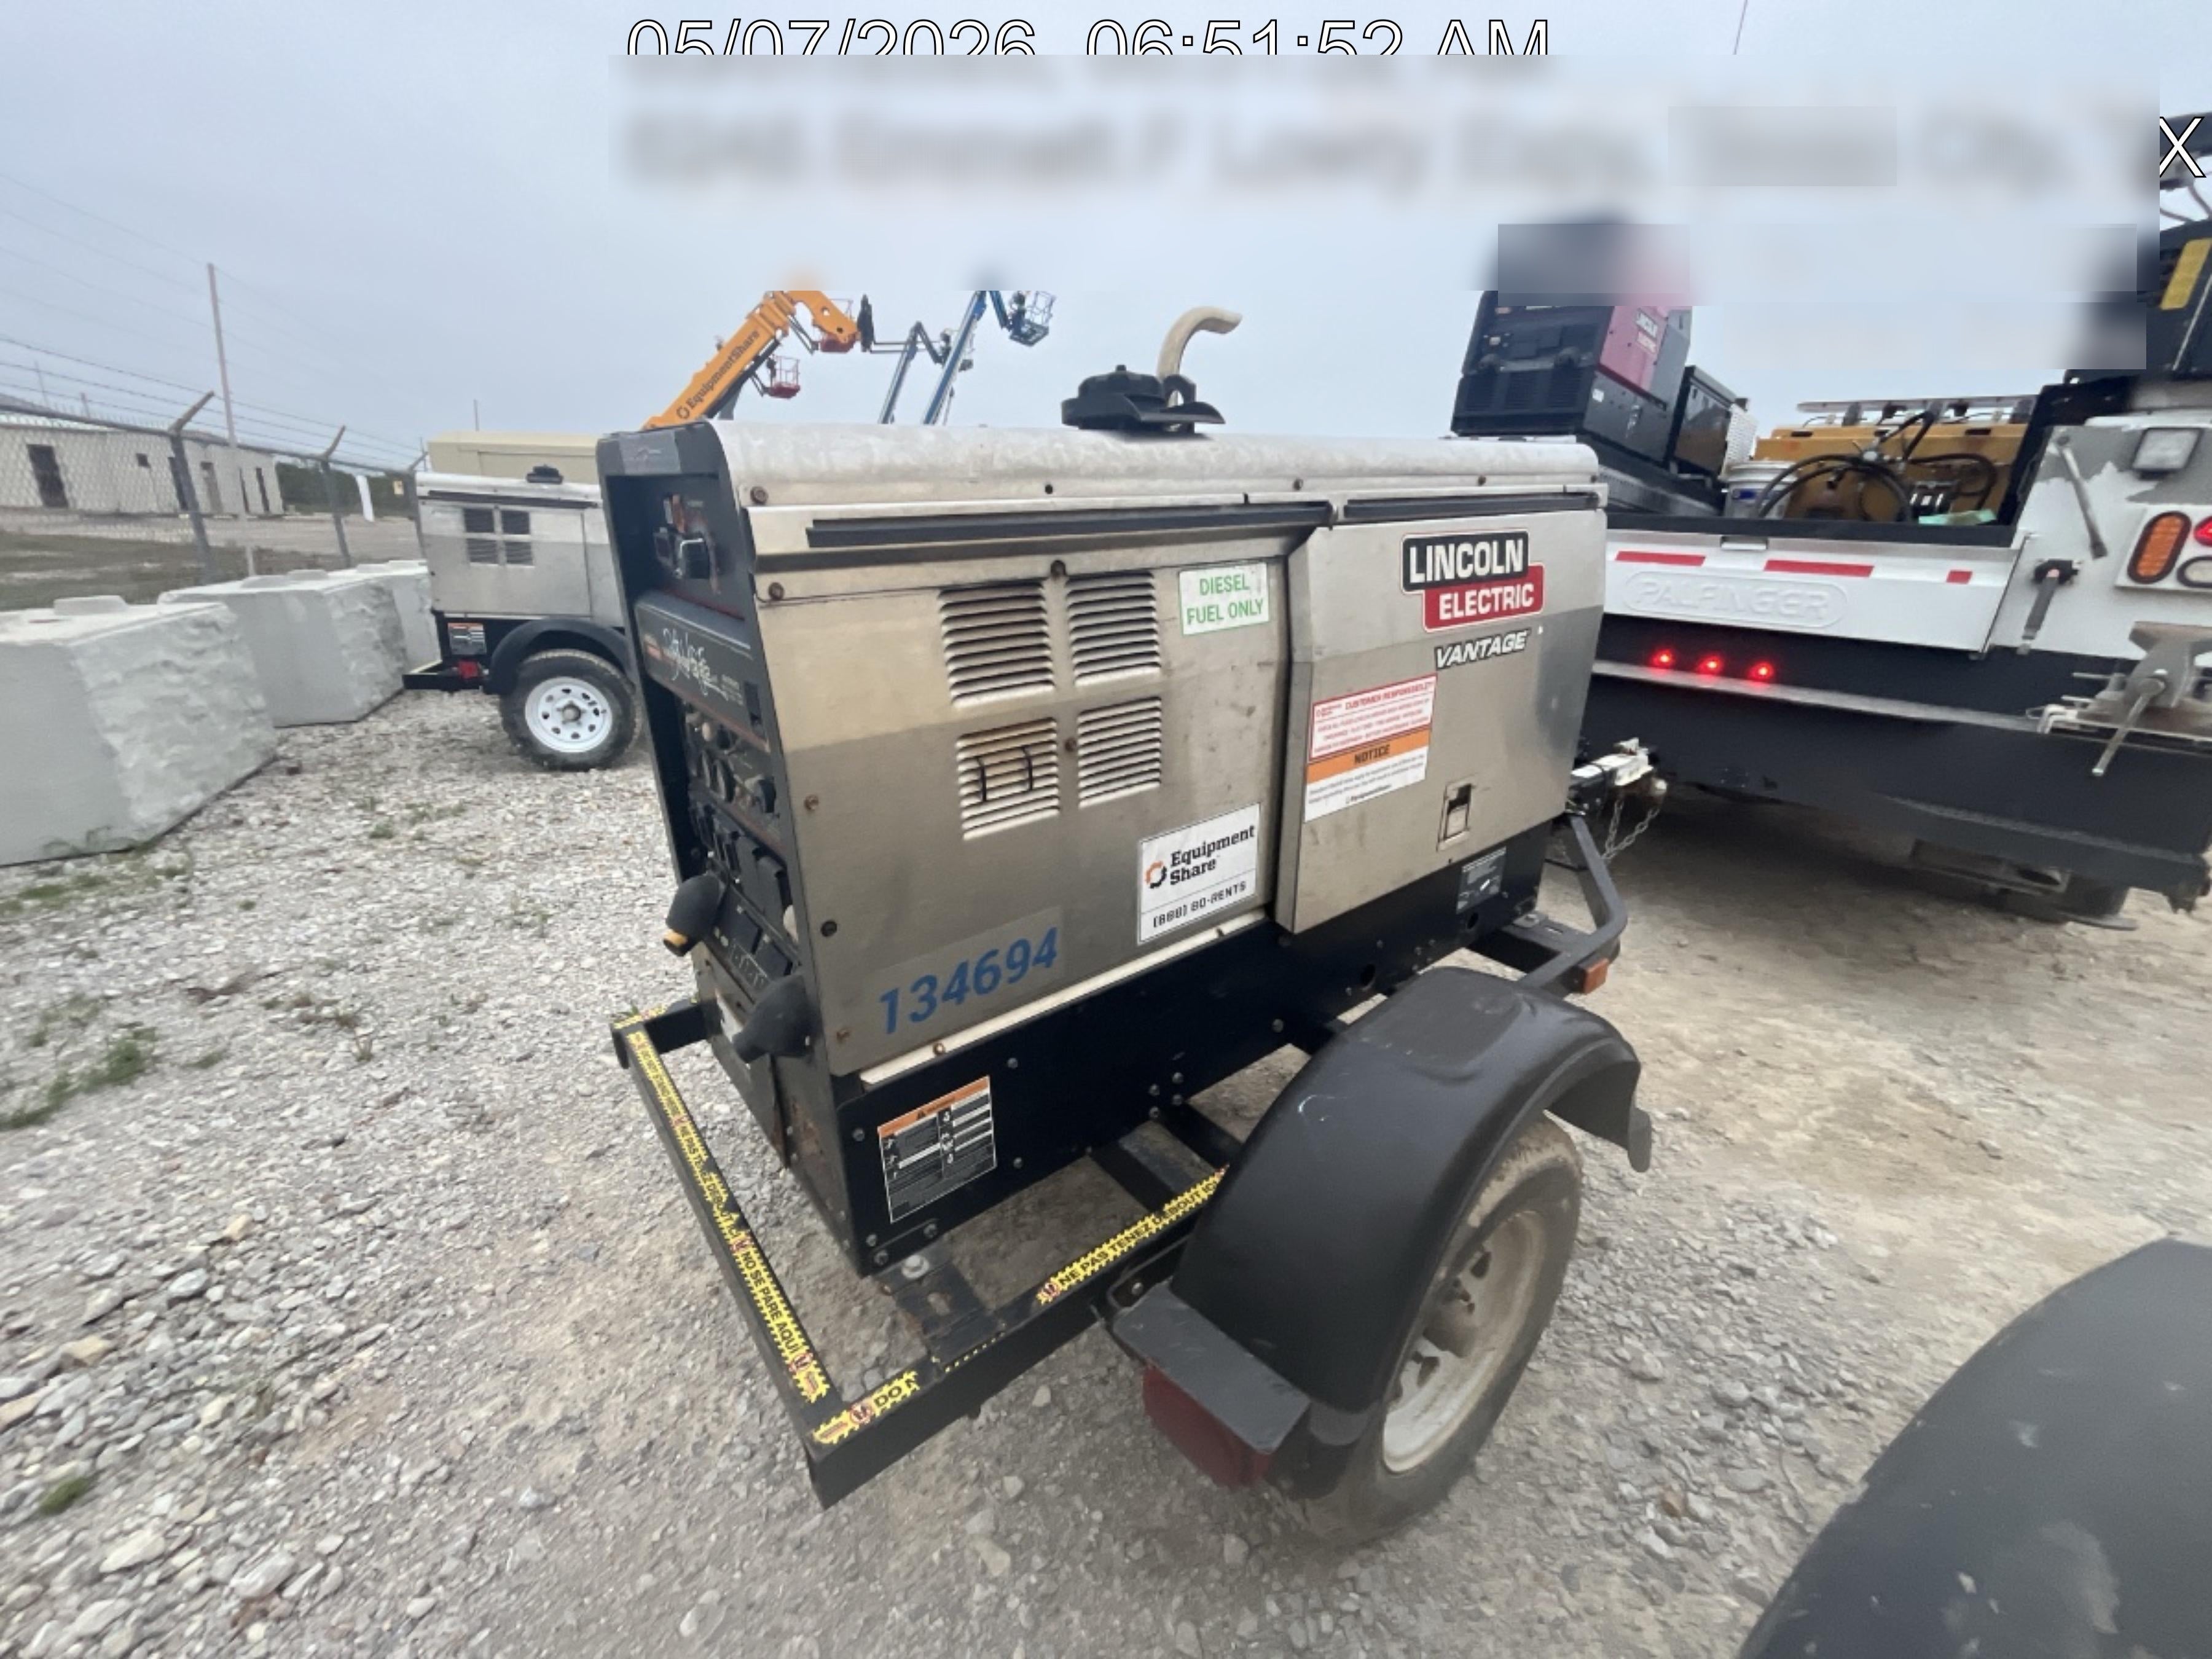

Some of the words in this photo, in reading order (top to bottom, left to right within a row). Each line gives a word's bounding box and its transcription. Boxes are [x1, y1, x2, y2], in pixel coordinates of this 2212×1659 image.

[686, 331, 760, 410] EquipmentShare
[1410, 539, 1524, 584] LINCOLN
[1199, 573, 1250, 595] DIESEL
[1439, 582, 1535, 621] ELECTRIC
[1635, 581, 1831, 621] PALFINGER
[1186, 604, 1224, 625] FUEL
[1229, 598, 1263, 618] ONLY
[1436, 629, 1529, 670] VANTAGE
[1354, 743, 1390, 764] NOTICE
[1170, 825, 1255, 868] Equipment
[1170, 858, 1217, 885] Share
[1153, 904, 1188, 928] (888)
[1191, 880, 1247, 912] 80-RENTS
[879, 926, 1058, 1034] 134694
[741, 1251, 756, 1269] NO
[750, 1269, 766, 1287] SE
[759, 1285, 783, 1320] PARE
[1058, 1269, 1081, 1285] NE
[1080, 1251, 1108, 1270] PAS
[874, 1386, 901, 1406] DO
